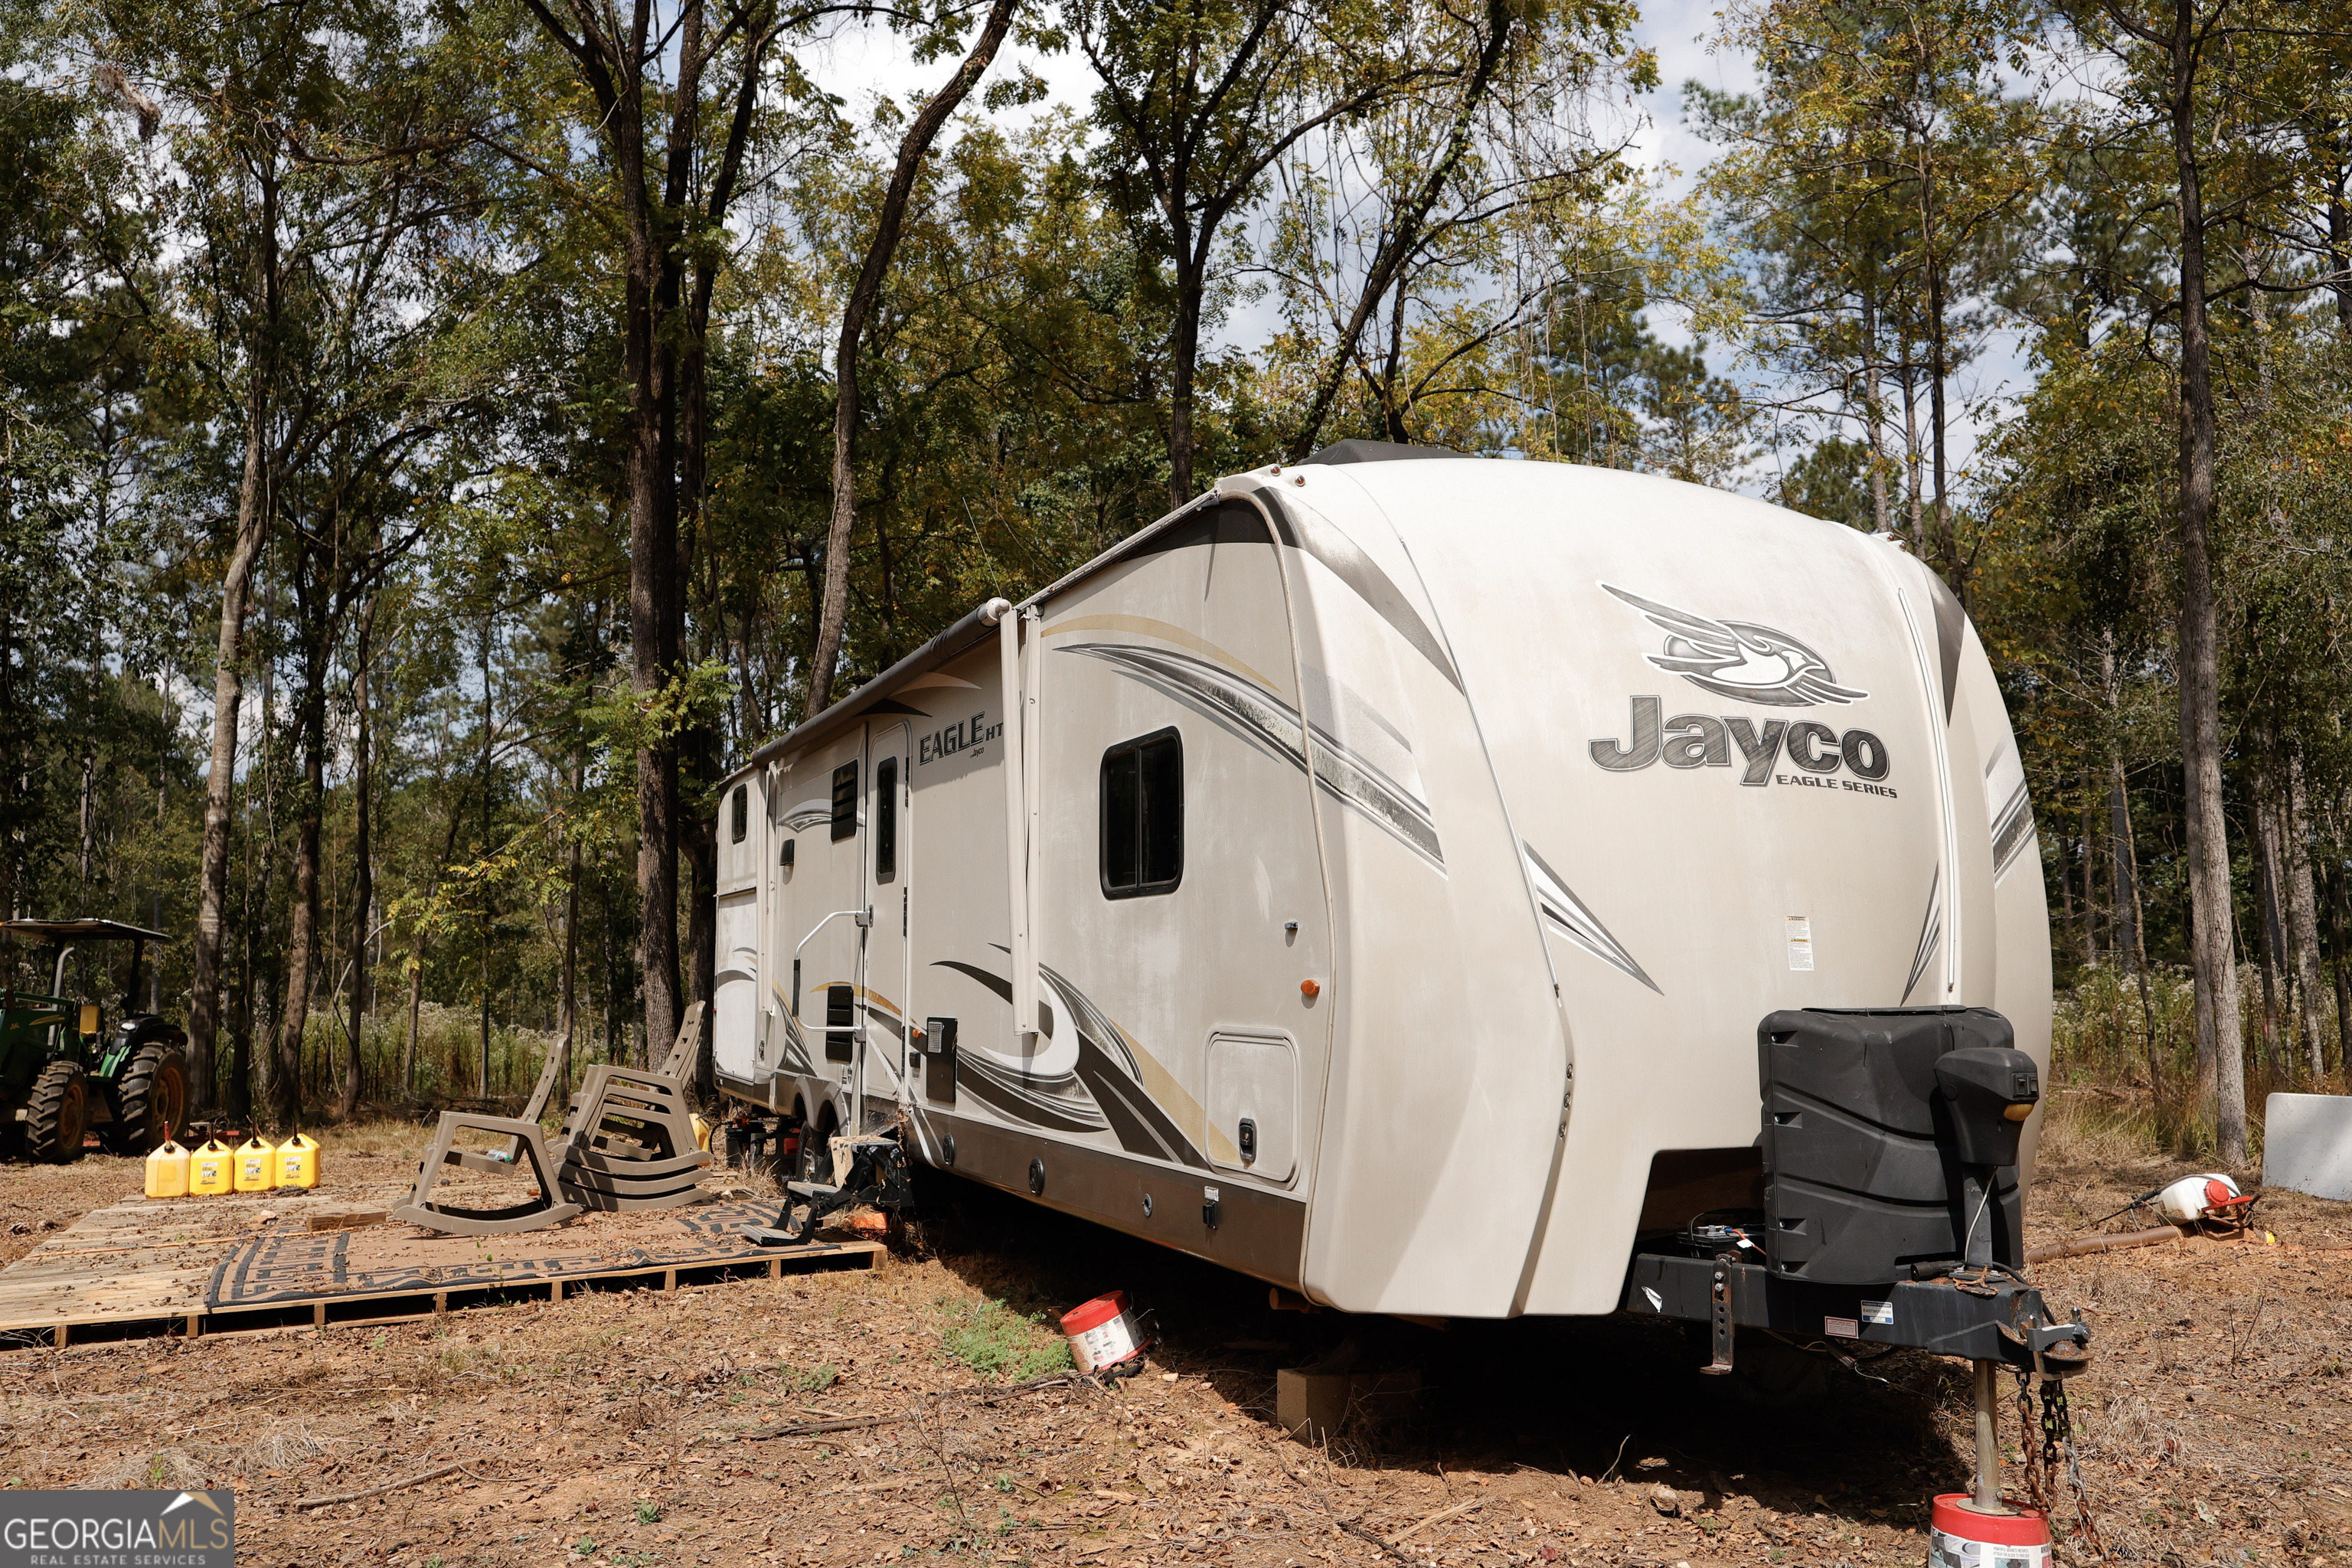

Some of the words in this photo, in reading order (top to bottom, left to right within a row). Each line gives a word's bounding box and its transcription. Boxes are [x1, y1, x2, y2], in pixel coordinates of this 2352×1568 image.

[920, 710, 985, 766] EAGLE
[986, 723, 1003, 741] HT
[1588, 694, 1890, 787] Jayco
[1775, 775, 1838, 789] EAGLE
[1842, 780, 1897, 799] SERIES
